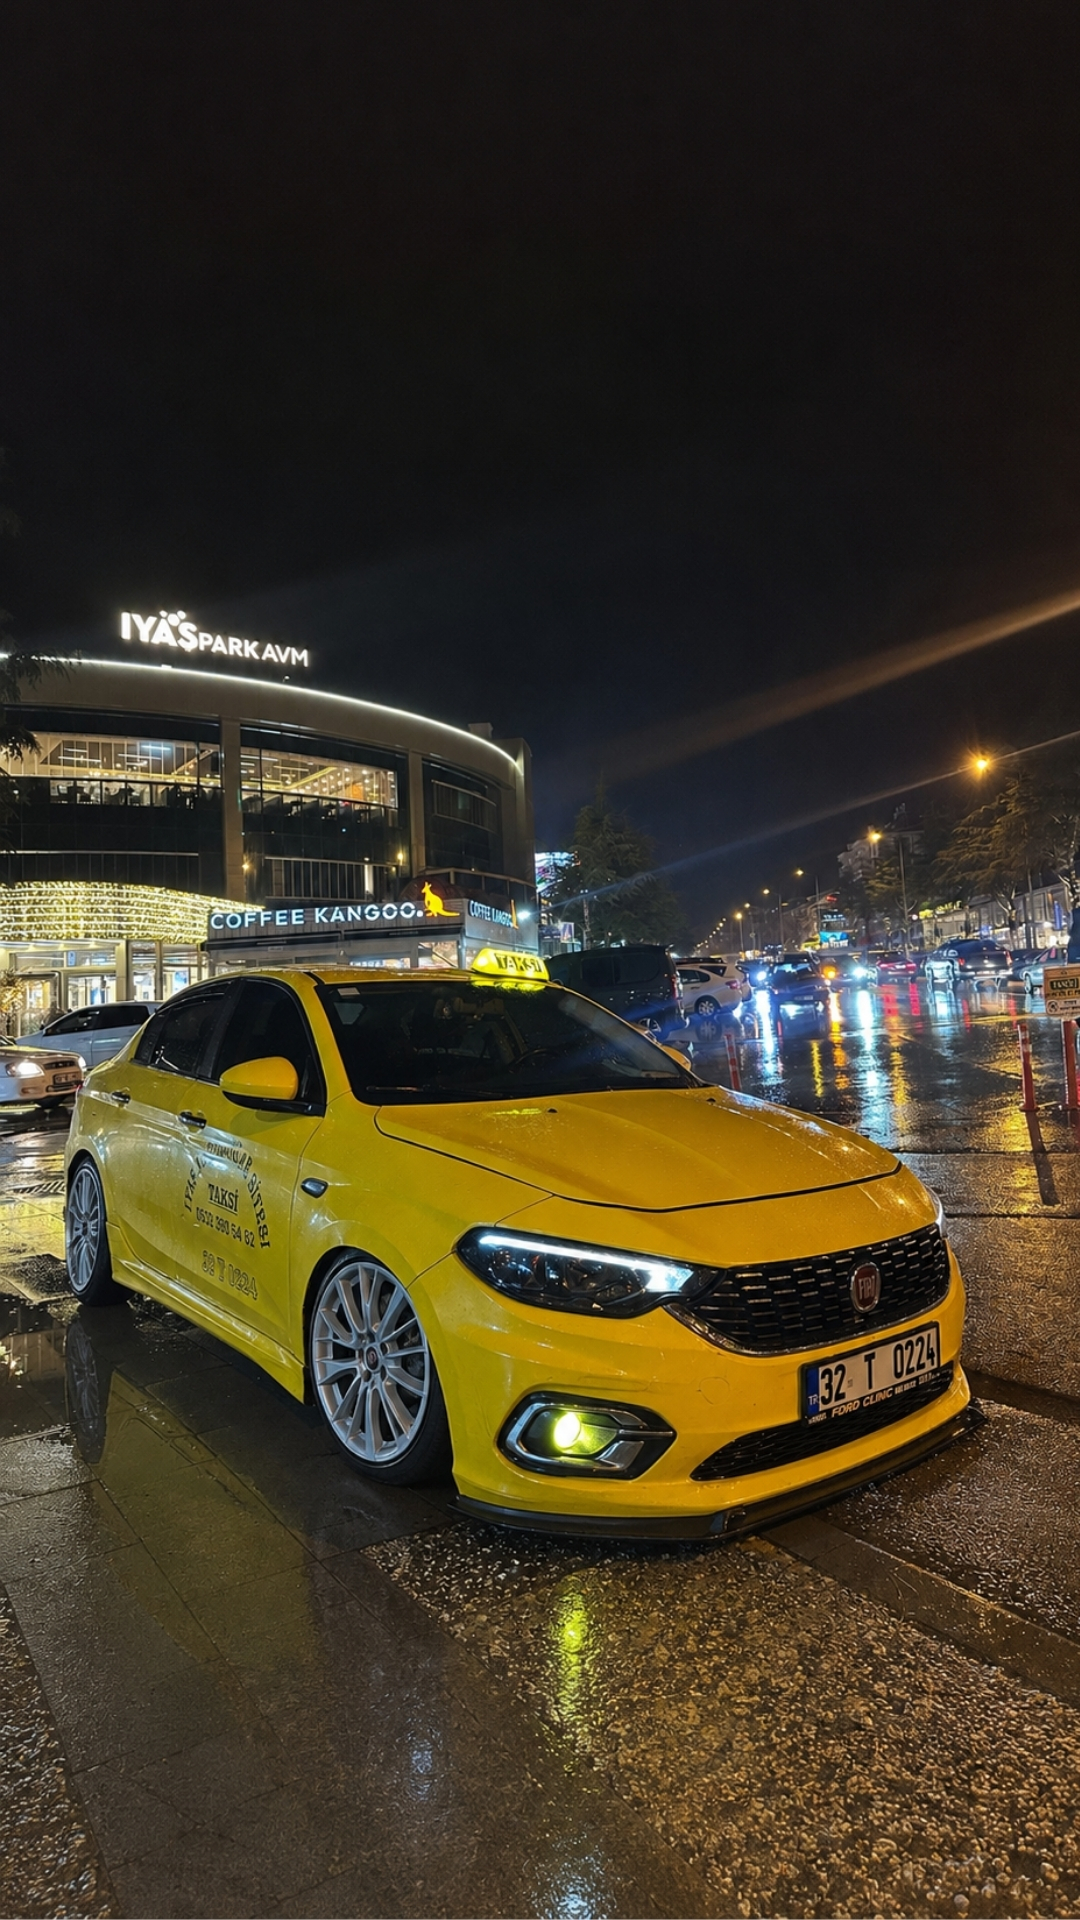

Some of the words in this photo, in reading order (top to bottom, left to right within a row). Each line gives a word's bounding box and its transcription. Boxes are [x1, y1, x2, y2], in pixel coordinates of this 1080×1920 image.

[261, 643, 309, 668] AVM
[210, 909, 304, 929] COFFEE
[208, 1183, 240, 1213] TAKSİ
[820, 1363, 847, 1406] 32
[864, 1352, 876, 1390] T
[894, 1333, 935, 1379] 0224
[832, 1400, 860, 1418] FORD
